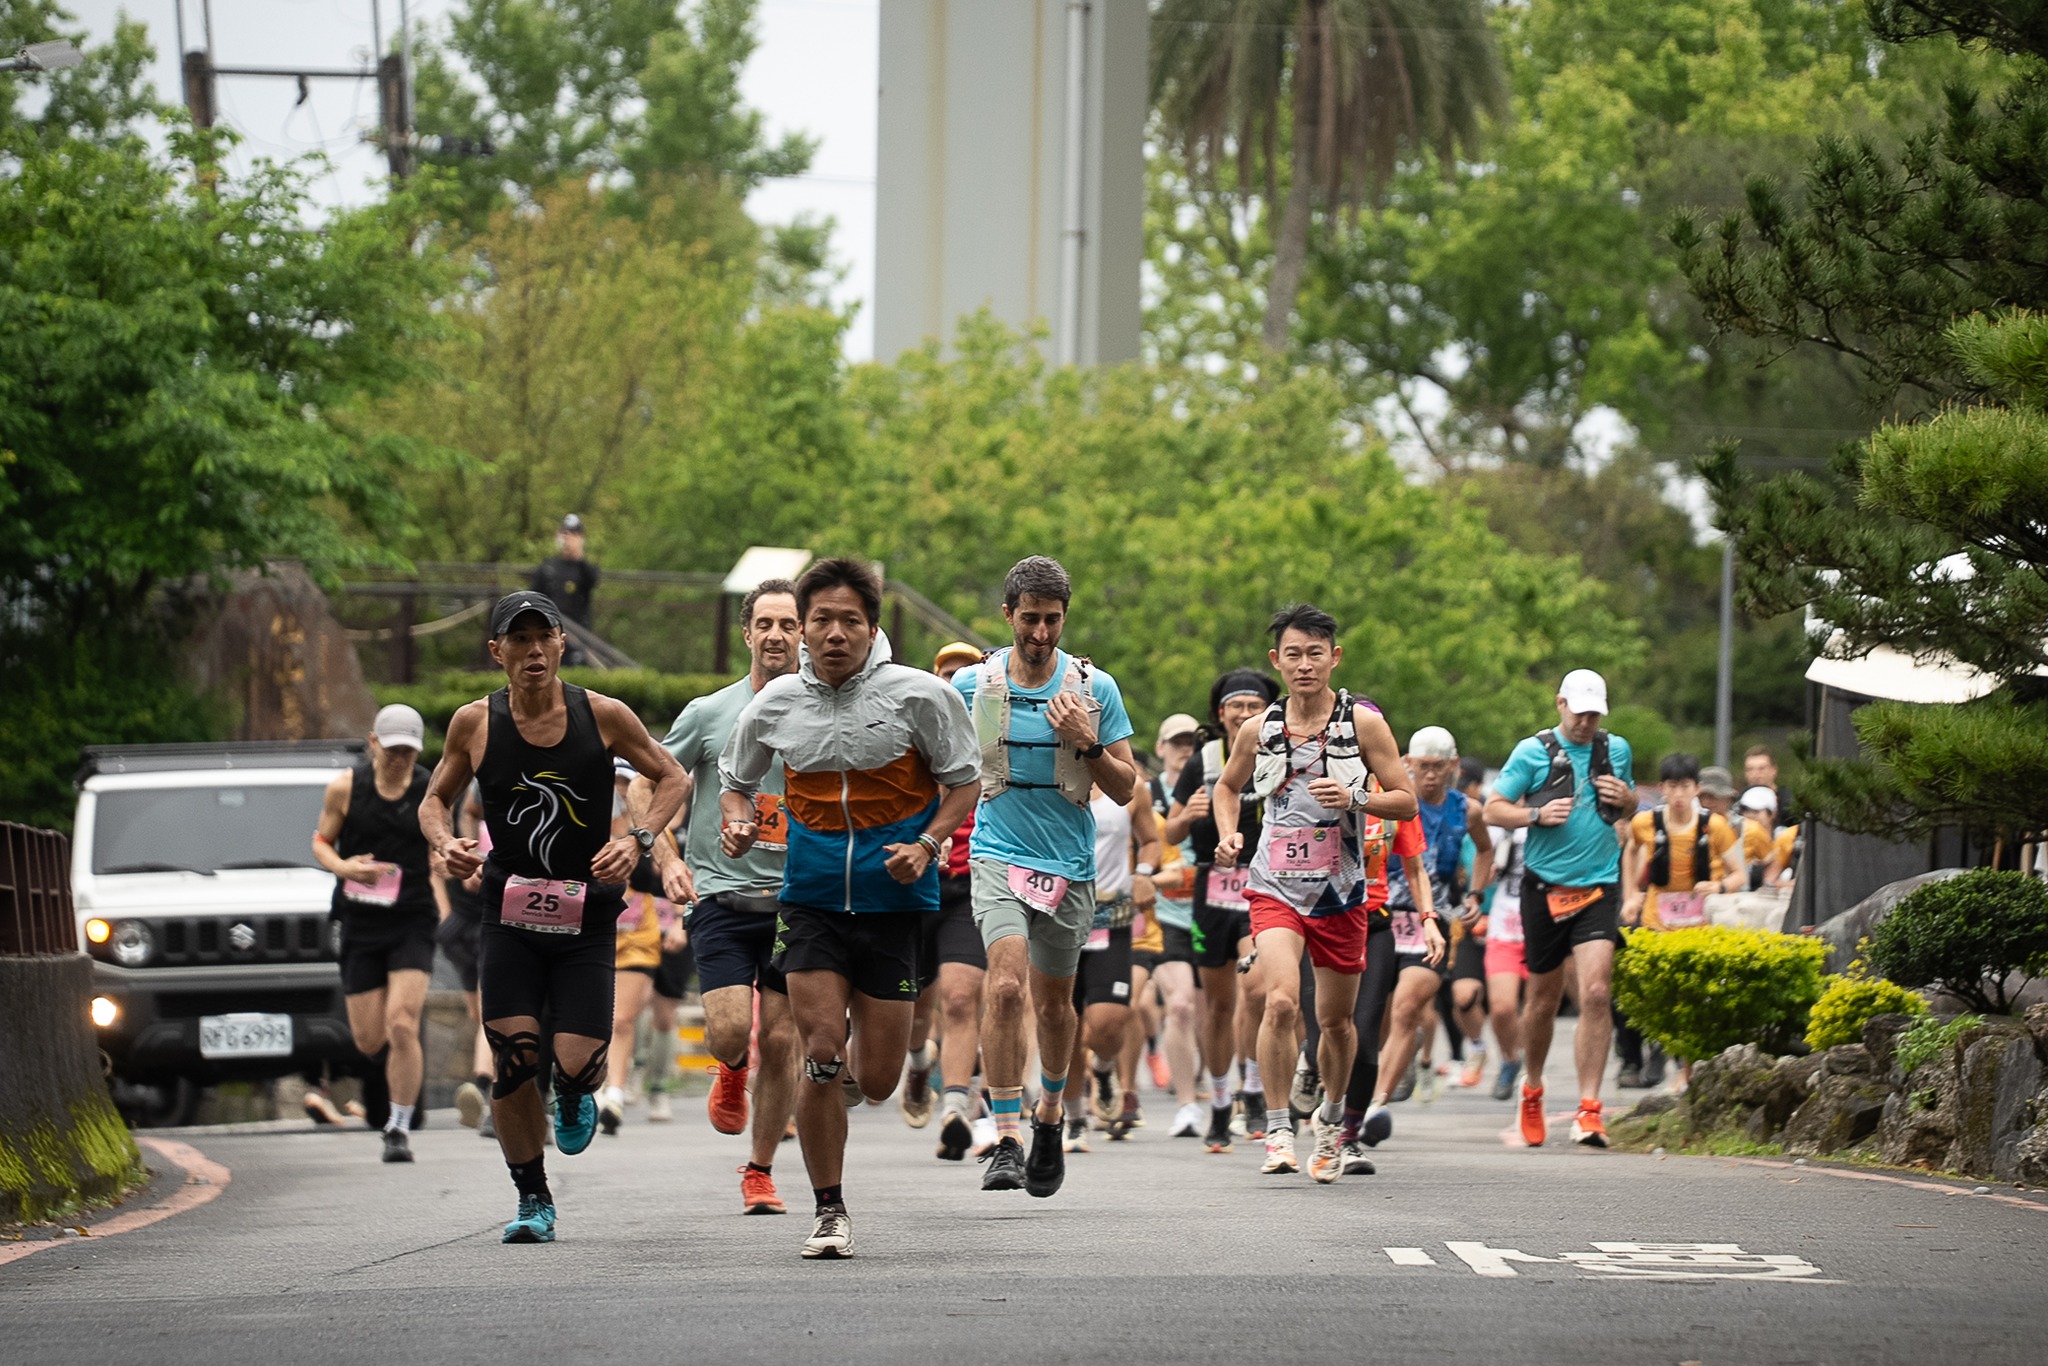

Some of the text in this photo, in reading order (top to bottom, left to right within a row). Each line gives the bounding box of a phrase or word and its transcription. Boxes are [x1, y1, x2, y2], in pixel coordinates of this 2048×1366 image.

[1286, 842, 1309, 859] 51
[1027, 873, 1054, 892] 40
[526, 892, 559, 912] 25
